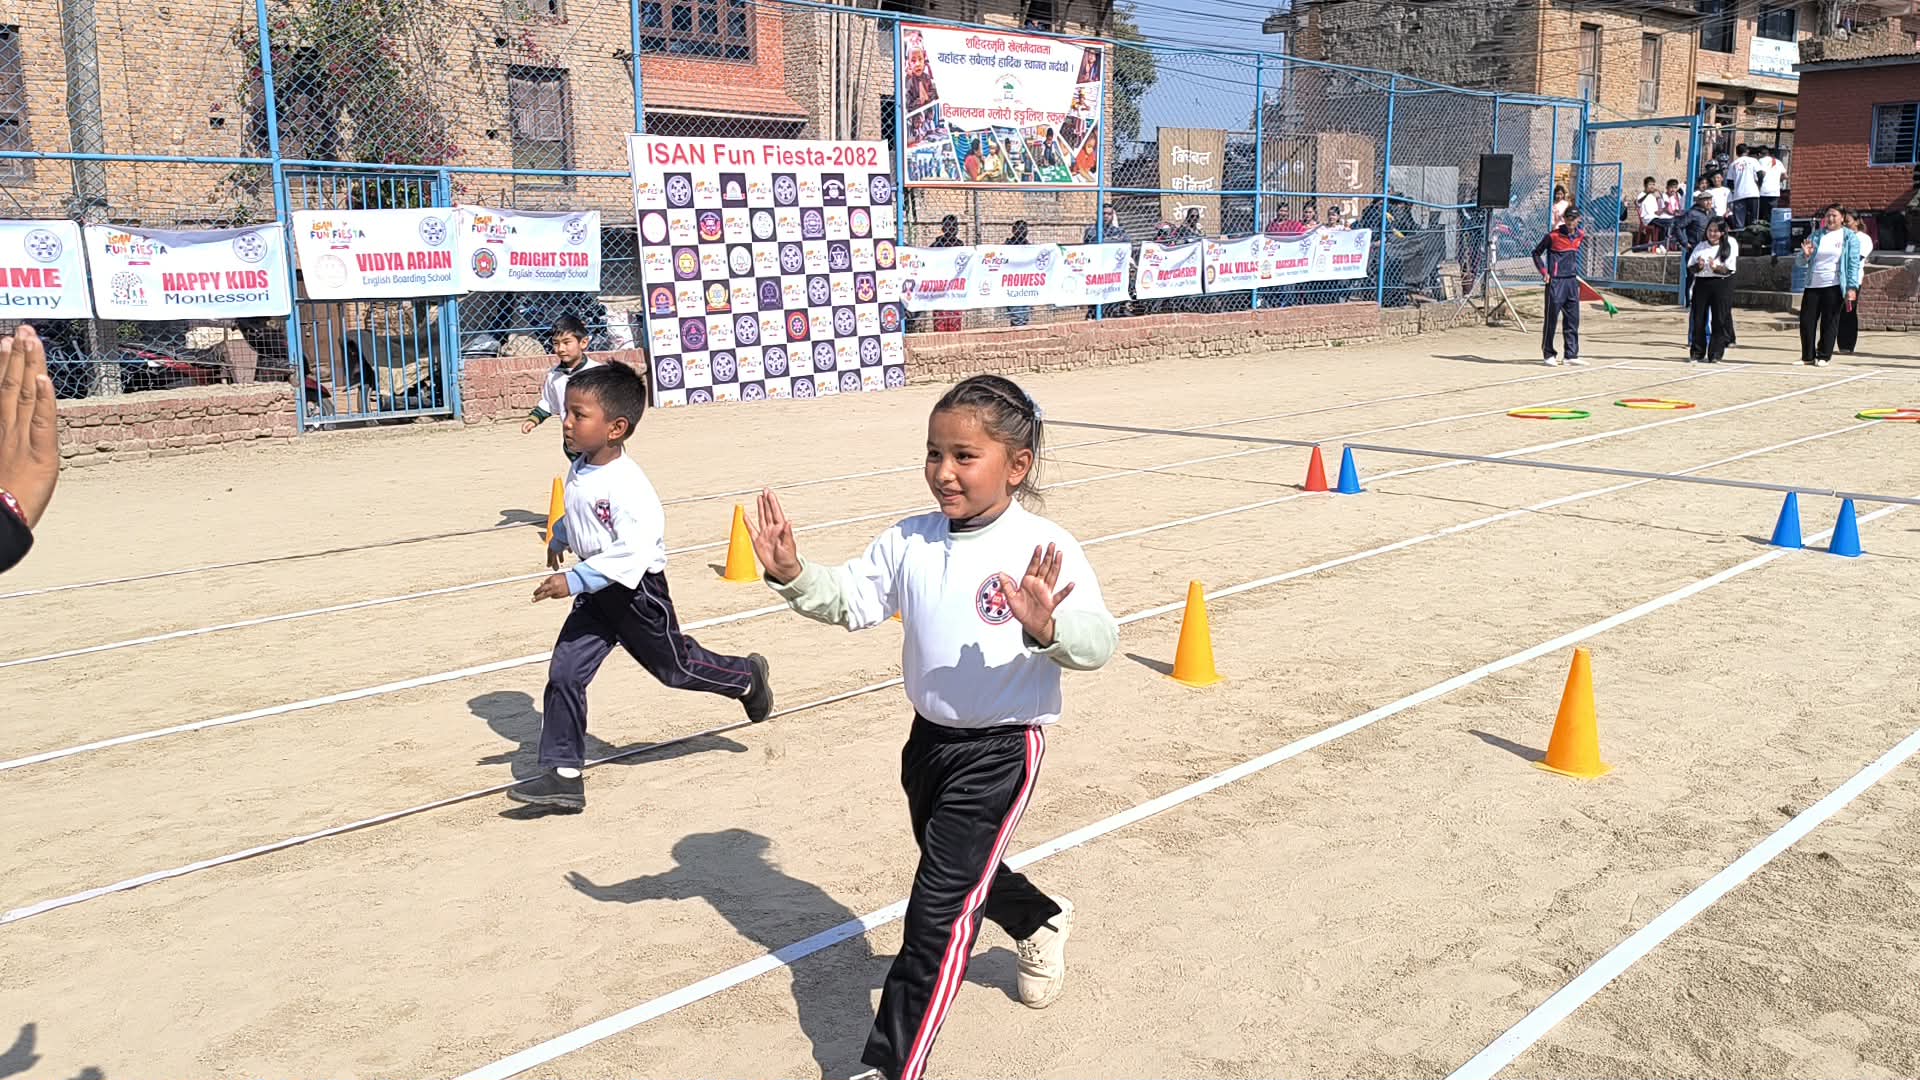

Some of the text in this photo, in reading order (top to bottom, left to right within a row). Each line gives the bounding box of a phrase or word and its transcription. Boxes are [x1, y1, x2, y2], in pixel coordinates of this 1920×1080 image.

[942, 103, 986, 119] हिमालयन
[647, 142, 878, 166] ISAN Fun Fiesta-2082
[355, 250, 452, 272] VIDYA ARJAN
[510, 251, 589, 267] BRIGHT STAR
[508, 268, 533, 280] English
[568, 270, 588, 279] School
[1219, 263, 1233, 275] BAL
[162, 270, 269, 292] HAPPY KIDS
[362, 271, 452, 287] English Boarding School
[1001, 272, 1047, 287] PROWESS
[165, 290, 269, 305] Montessori
